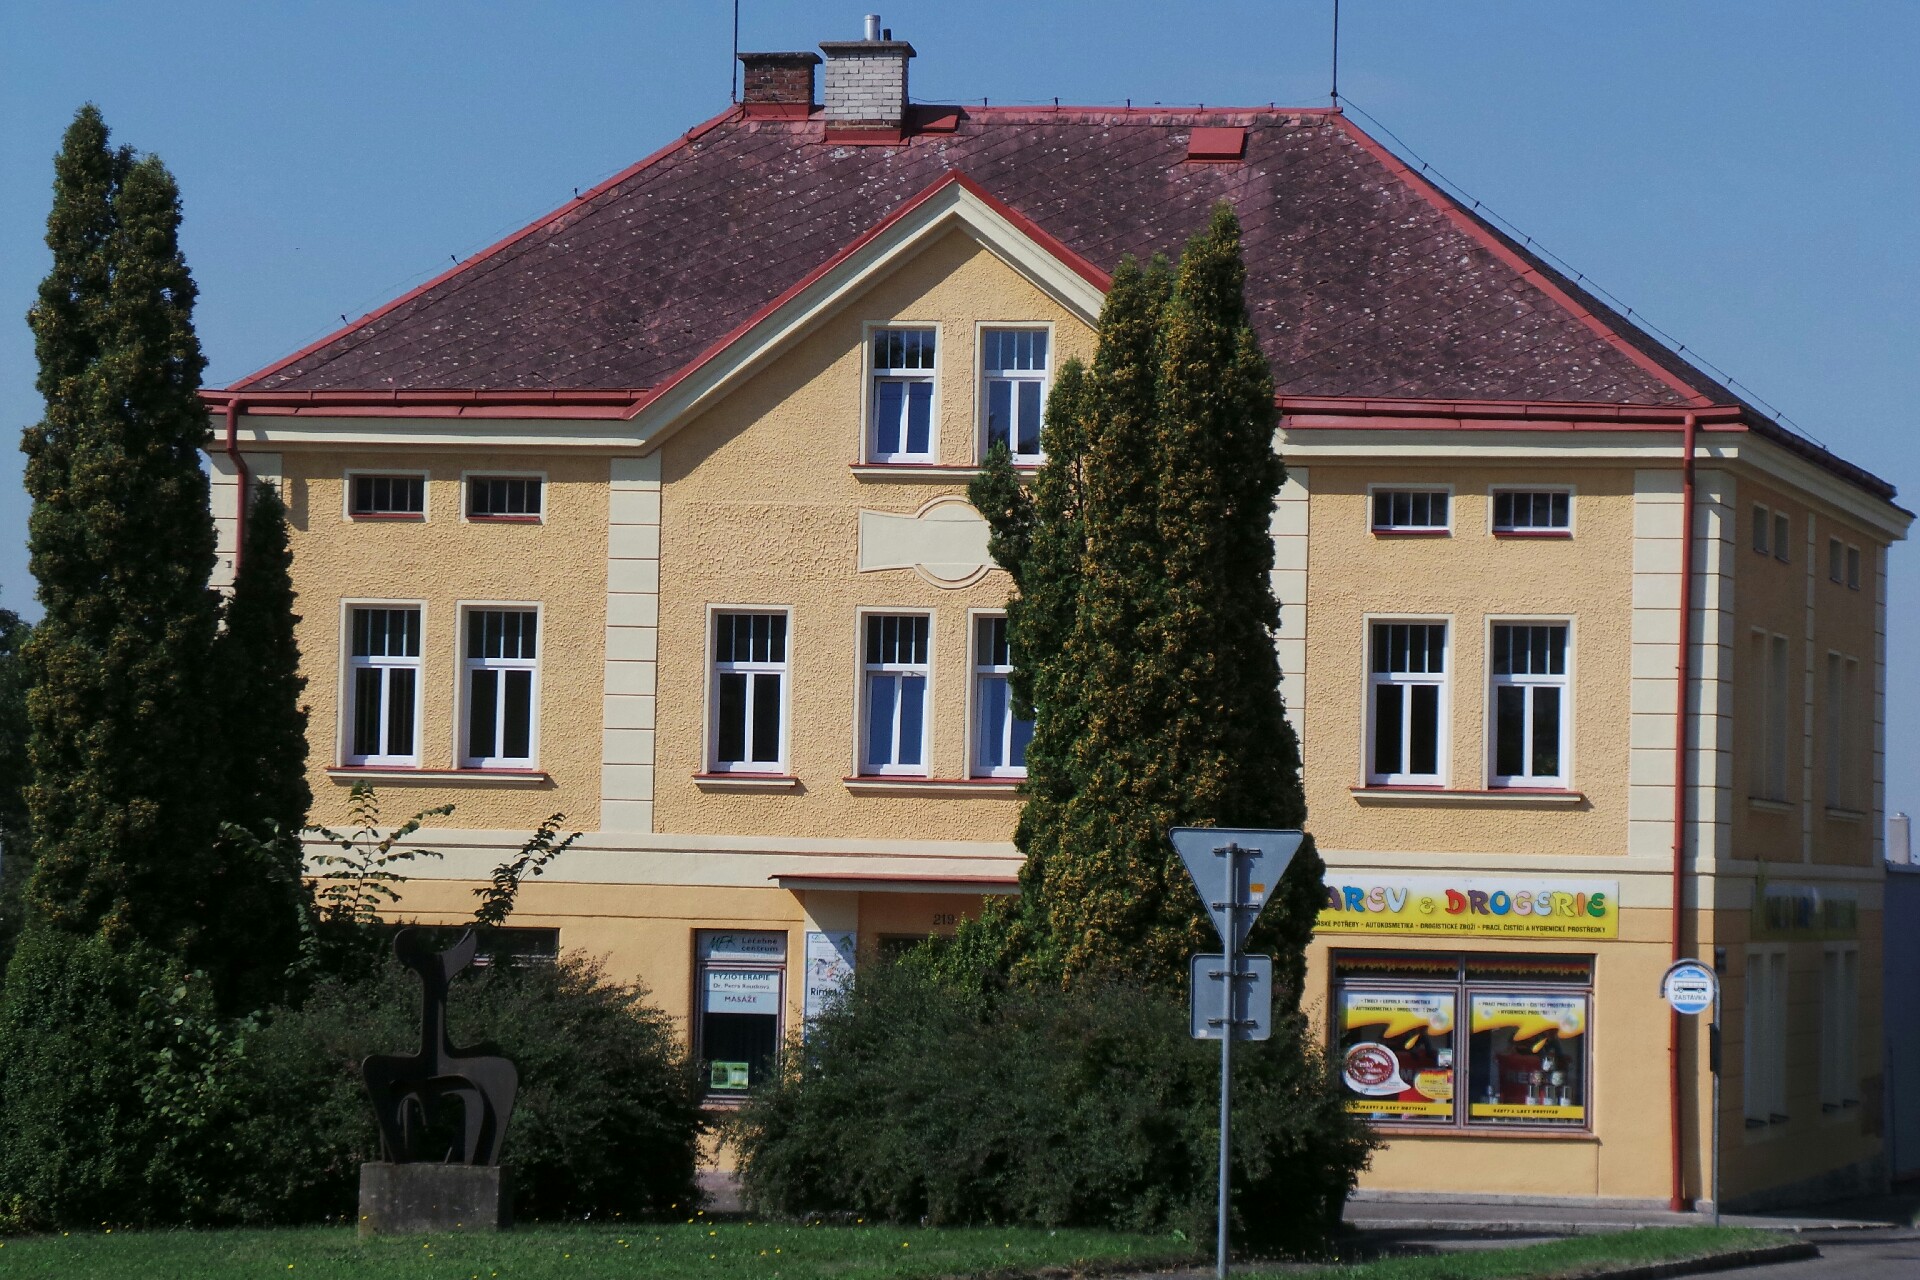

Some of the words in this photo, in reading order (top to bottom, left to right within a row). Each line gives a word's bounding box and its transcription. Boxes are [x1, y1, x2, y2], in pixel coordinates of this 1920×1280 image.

[1326, 885, 1407, 913] AREV
[1445, 889, 1606, 917] DROGERIE
[933, 914, 955, 925] 219
[1333, 920, 1359, 929] POTŘEBY
[1420, 922, 1458, 930] DROGISTICKÉ
[1567, 925, 1606, 933] PROSTŘEDKY
[713, 973, 769, 981] FYZIOTERAPIE
